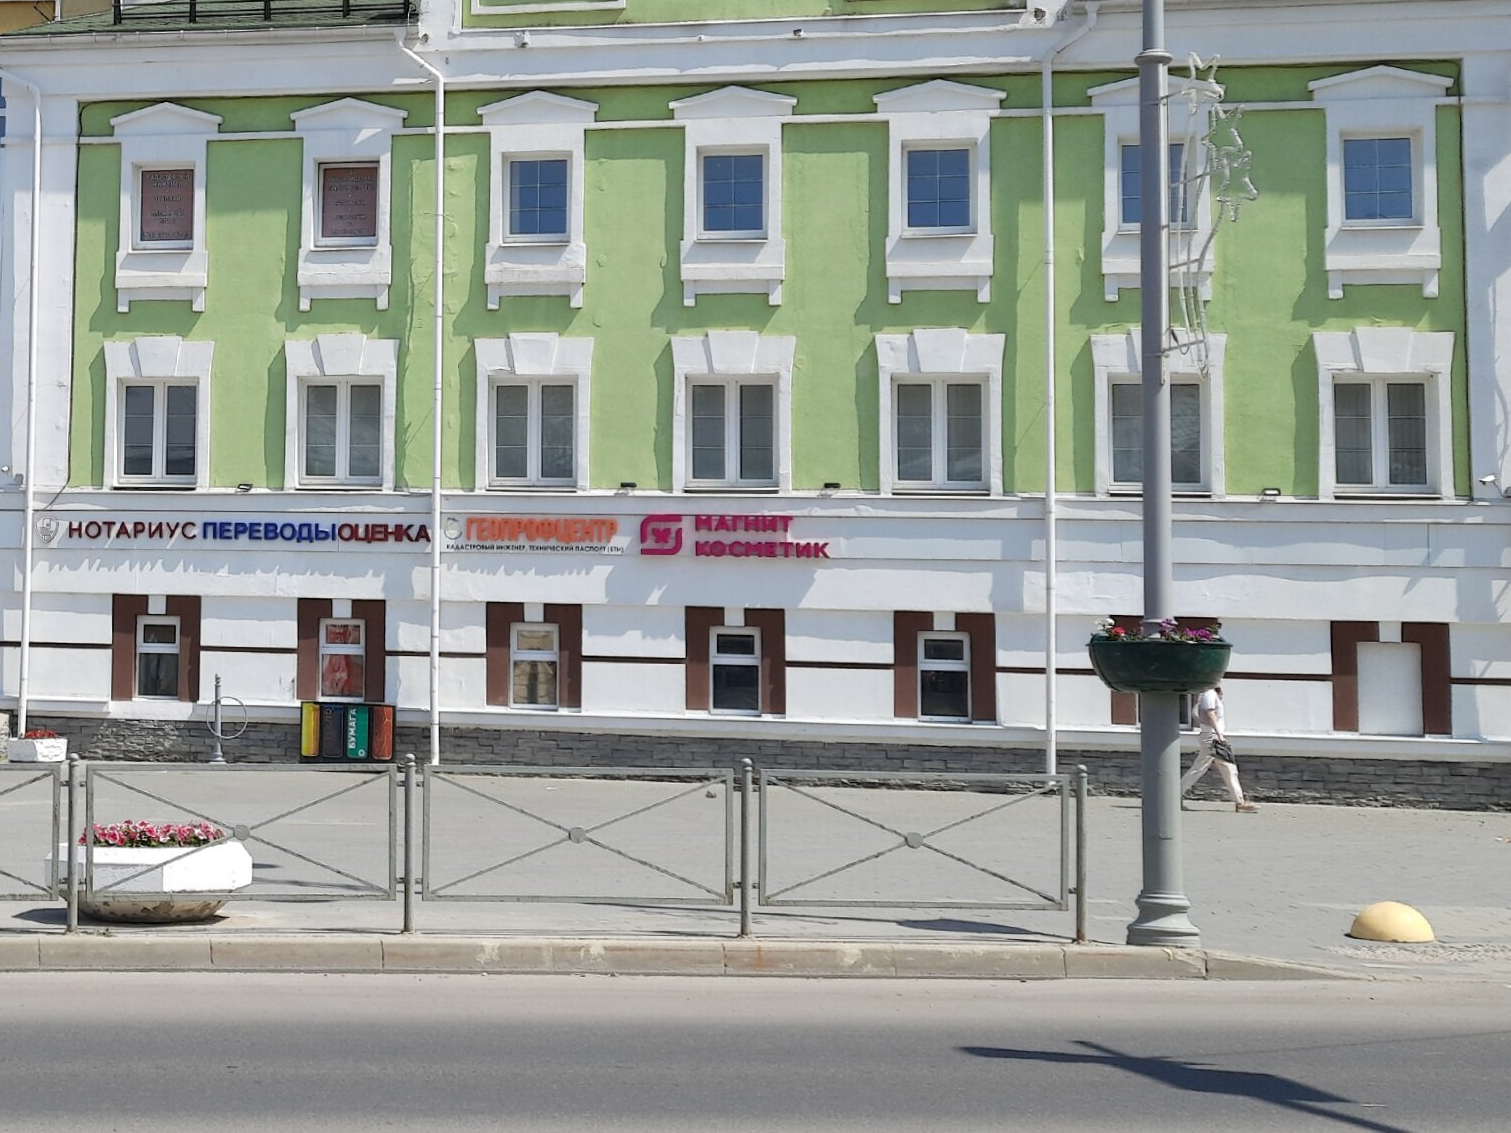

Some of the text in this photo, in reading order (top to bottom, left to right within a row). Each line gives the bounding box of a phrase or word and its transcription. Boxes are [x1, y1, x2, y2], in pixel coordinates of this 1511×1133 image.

[68, 521, 432, 543] НОТАРИУС ПЕРЕВОДЫ ОЦЕНКА
[465, 517, 619, 543] ГЕОПРОФЦЕНТР
[695, 514, 793, 533] МАГНИТ
[446, 543, 495, 551] КАДАСТРОВЫЙ
[529, 544, 574, 552] ТЕХНИЧЕСКИЙ
[575, 545, 607, 553] ПАСПОРТ
[695, 540, 831, 559] КОСМЕТИК
[348, 708, 357, 749] БУМАГА
